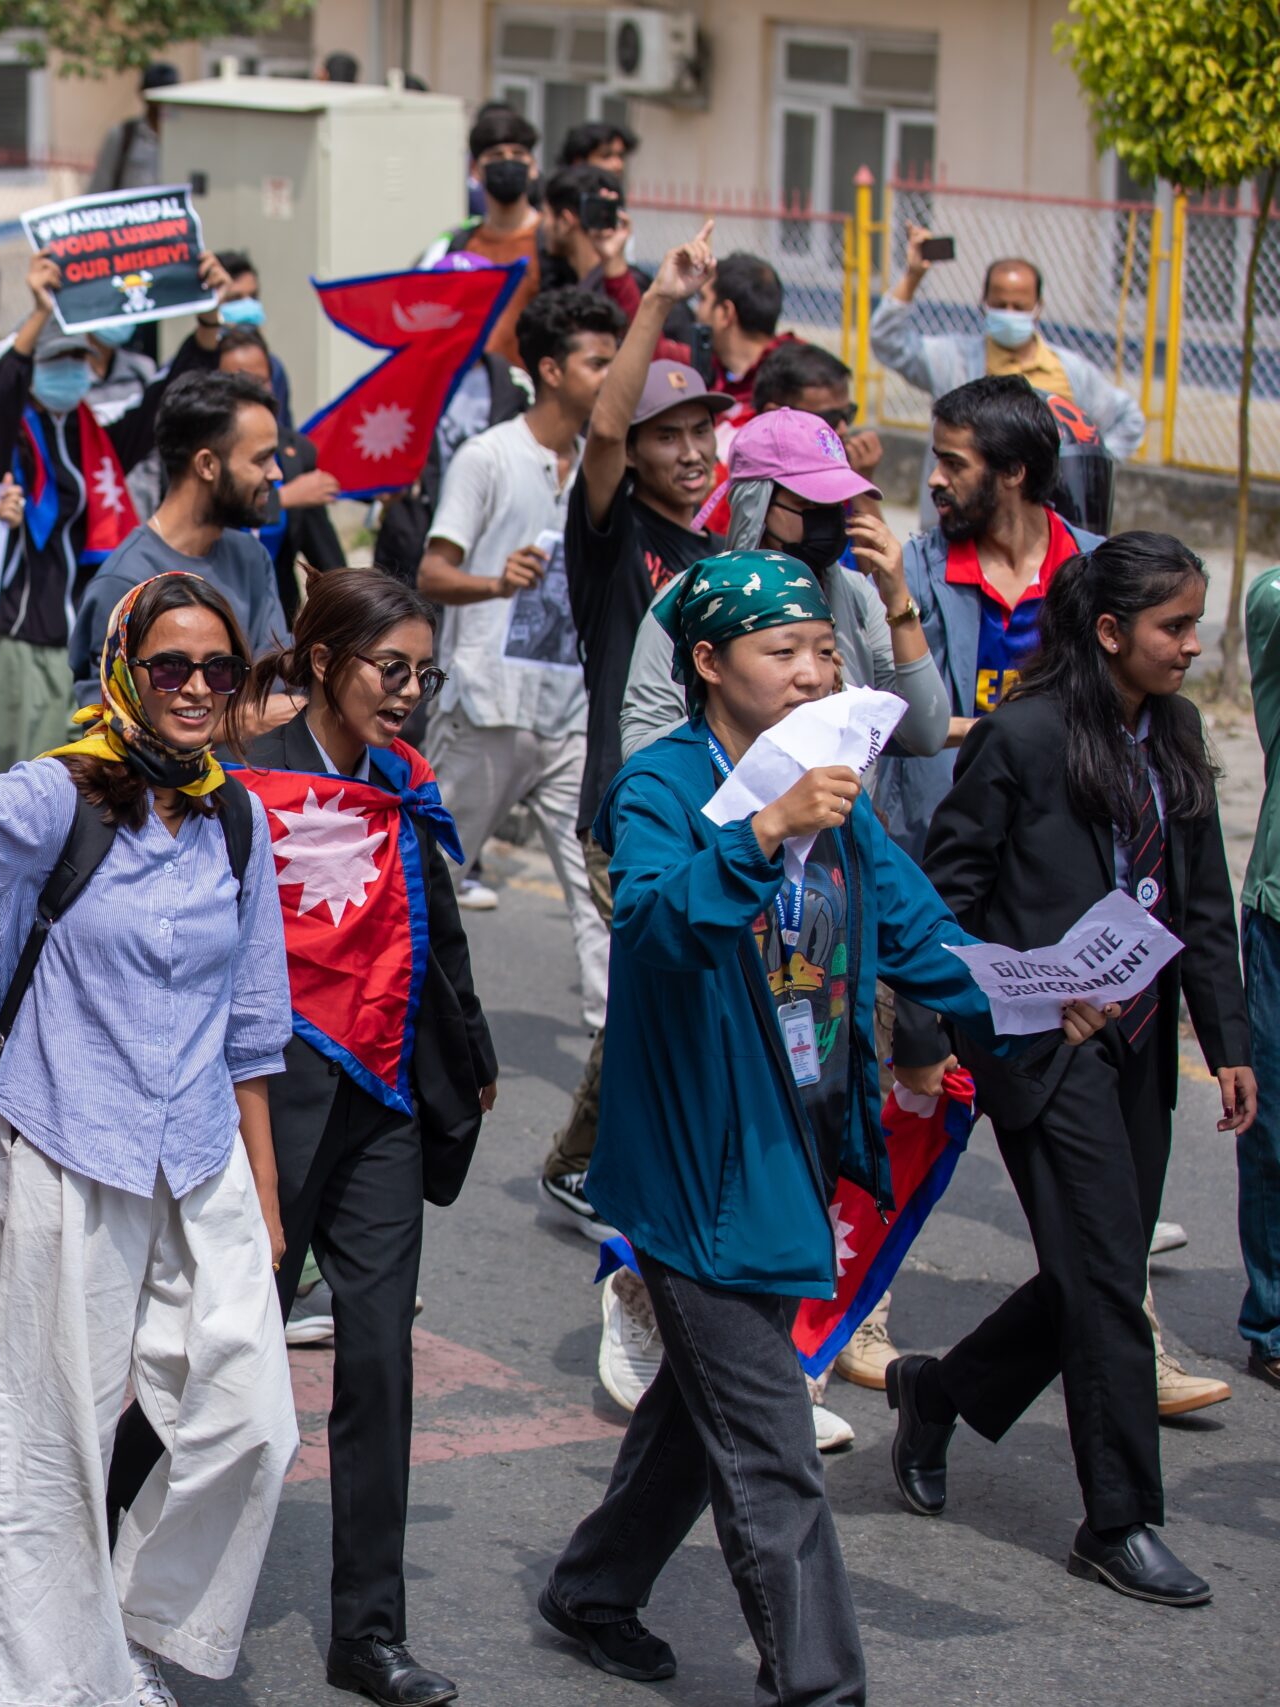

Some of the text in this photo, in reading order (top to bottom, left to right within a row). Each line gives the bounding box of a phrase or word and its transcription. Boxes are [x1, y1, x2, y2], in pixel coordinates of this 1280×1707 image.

[37, 196, 187, 241] #WAKEUPNEPAL
[50, 218, 189, 258] YOUR LUXURY
[65, 242, 190, 283] OUR MISERY!
[990, 926, 1124, 980] GLITCH THE
[998, 939, 1150, 998] GOVERNMENT
